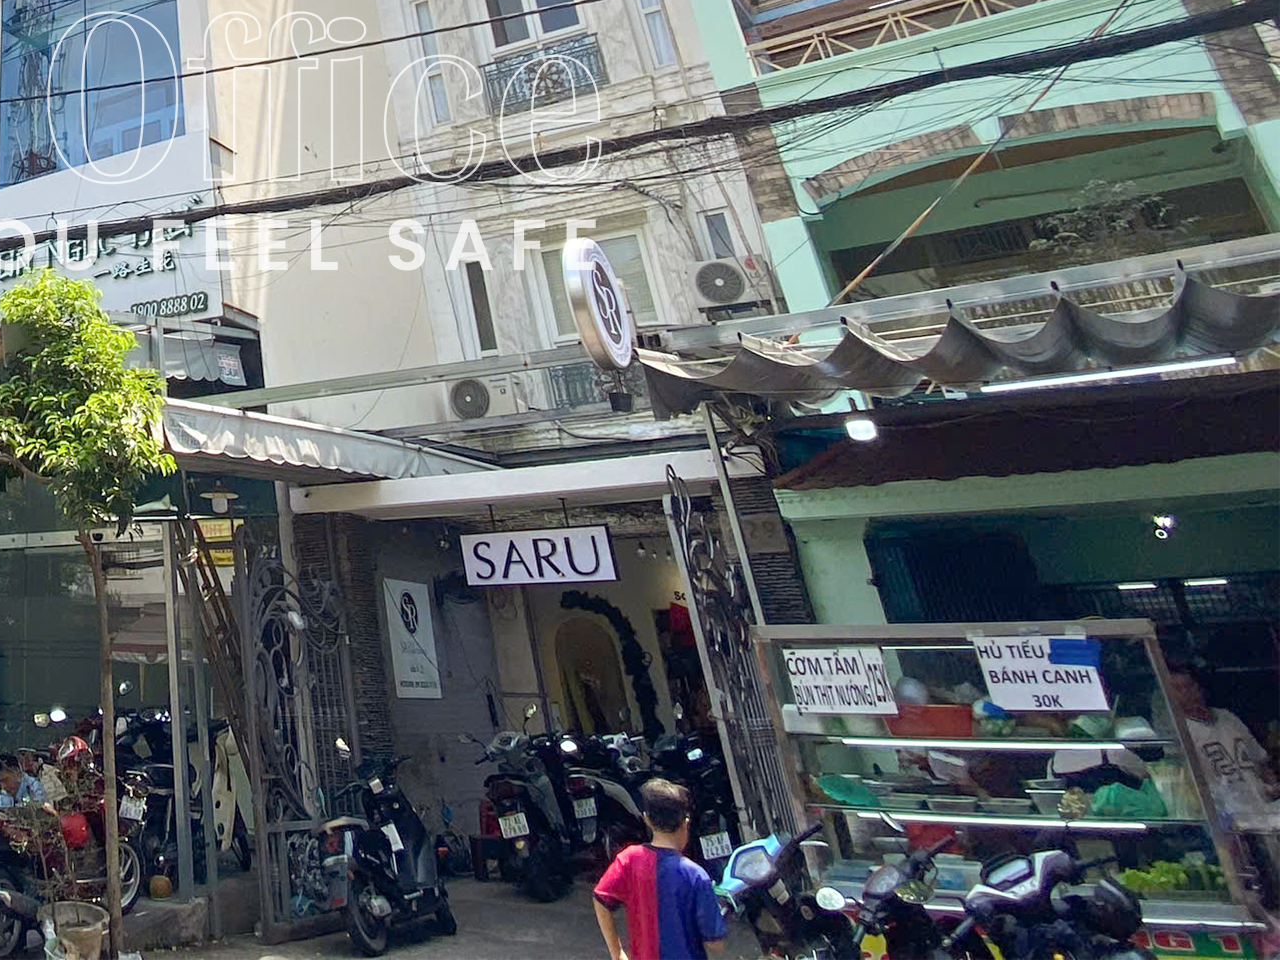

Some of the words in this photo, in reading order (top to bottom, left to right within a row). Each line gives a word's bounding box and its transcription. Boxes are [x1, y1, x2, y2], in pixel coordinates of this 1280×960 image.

[160, 297, 188, 316] 8888
[190, 293, 205, 310] 02
[472, 534, 601, 581] SARU
[1005, 639, 1046, 660] TIẾU
[988, 666, 1038, 685] BÁNH
[1042, 669, 1093, 685] CANH
[1032, 694, 1064, 709] 30K
